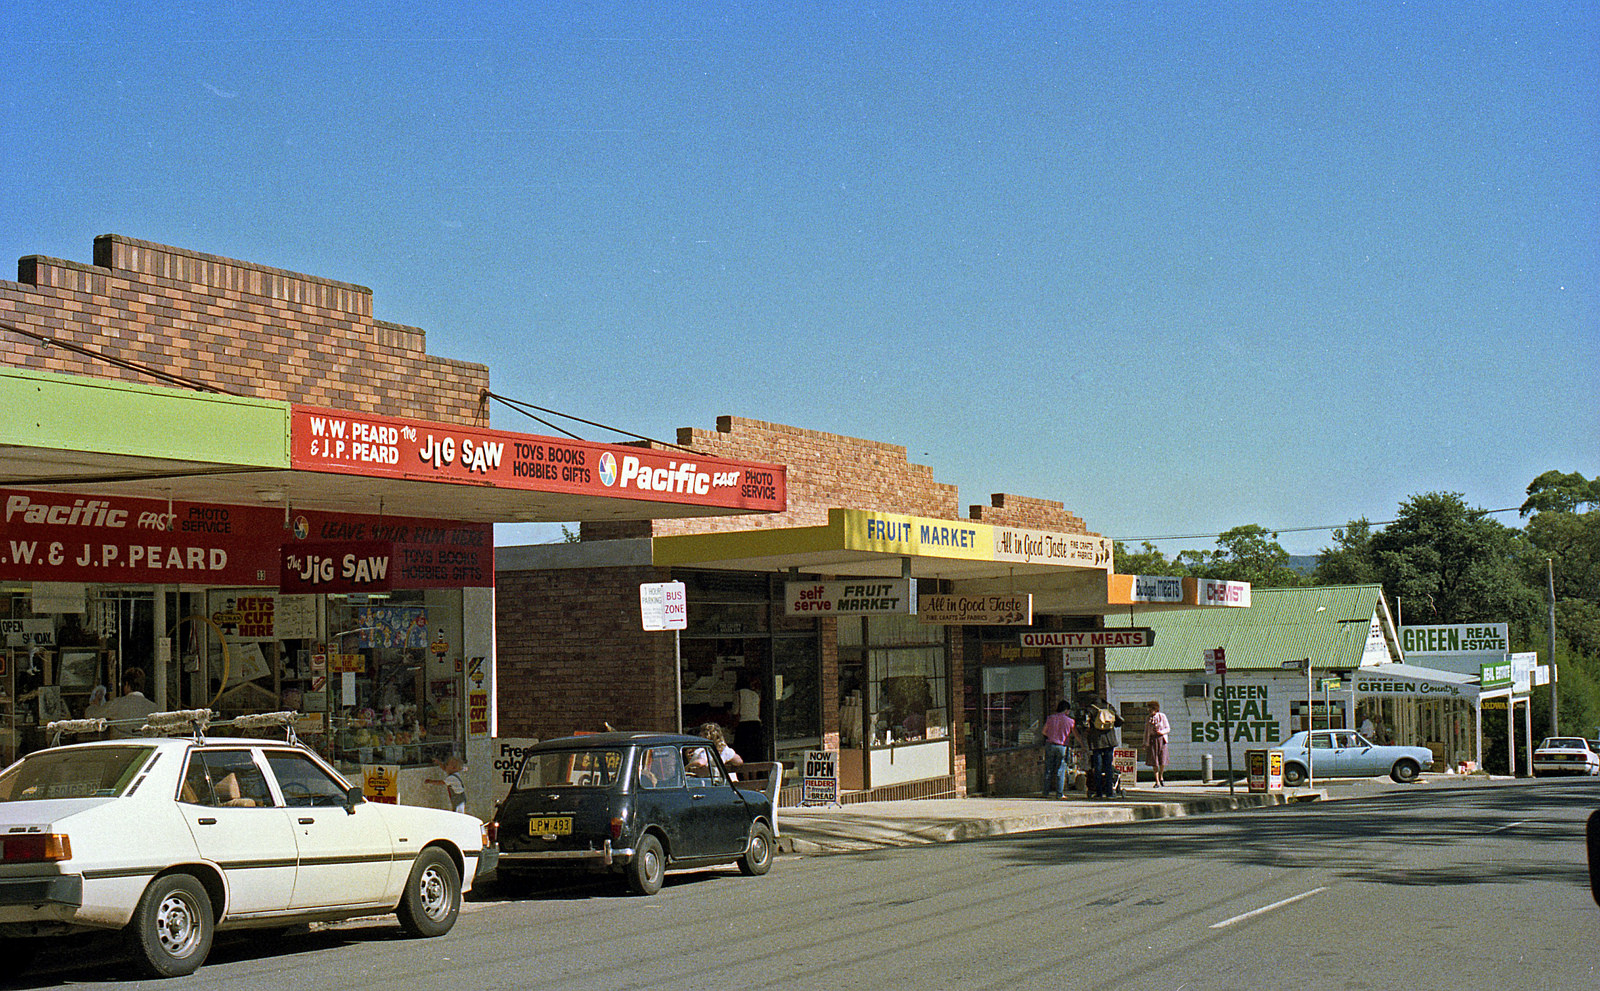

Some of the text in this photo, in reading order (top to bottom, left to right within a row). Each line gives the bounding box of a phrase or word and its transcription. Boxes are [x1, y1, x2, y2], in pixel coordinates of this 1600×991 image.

[310, 416, 398, 445] W.W. PEARD
[310, 438, 399, 465] & J.P. PEARD
[400, 425, 505, 474] The JIG SAW
[514, 442, 585, 466] TOYS BOOKS
[513, 461, 557, 481] HOBBIES
[562, 467, 591, 484] GIFTS
[619, 455, 741, 495] Pacific FAST
[745, 470, 773, 486] PHOTO
[741, 484, 776, 500] SERVICE
[6, 495, 177, 532] Pacific FAST
[188, 507, 229, 520] PHOTO
[181, 520, 232, 534] SERVICE
[320, 521, 485, 547] LEAVE YOUR FILM HERE
[867, 519, 976, 549] FRUIT MARKET
[997, 532, 1067, 563] All in Good Taste
[402, 551, 479, 565] TOYS BOOKS
[342, 553, 389, 583] SAW
[401, 567, 482, 581] HOBBIES GIFTS
[666, 591, 682, 600] BUS
[800, 586, 824, 600] self
[844, 584, 893, 597] FRUIT
[1206, 583, 1244, 603] CHEMIST
[236, 597, 275, 611] KEYS
[664, 604, 684, 614] ZONE
[794, 600, 832, 611] serve
[837, 597, 900, 611] MARKET
[921, 596, 1021, 616] All in Good Taste
[243, 611, 275, 624] CUT
[2, 621, 24, 633] OPEN
[239, 624, 274, 637] HERE
[1466, 627, 1500, 639] REAL
[1024, 632, 1143, 646] QUALITY MEATS
[1403, 628, 1459, 652] GREEN
[1461, 638, 1506, 651] ESTATE
[1214, 685, 1268, 699] GREEN
[1357, 682, 1461, 696] GREEN Country
[470, 694, 487, 706] KEYS
[470, 707, 487, 721] CUT
[1212, 700, 1273, 720] REAL
[1191, 721, 1280, 743] ESTATE
[500, 743, 530, 757] Free
[809, 752, 831, 761] NOW
[1114, 750, 1135, 758] FREE
[807, 761, 834, 777] OPEN
